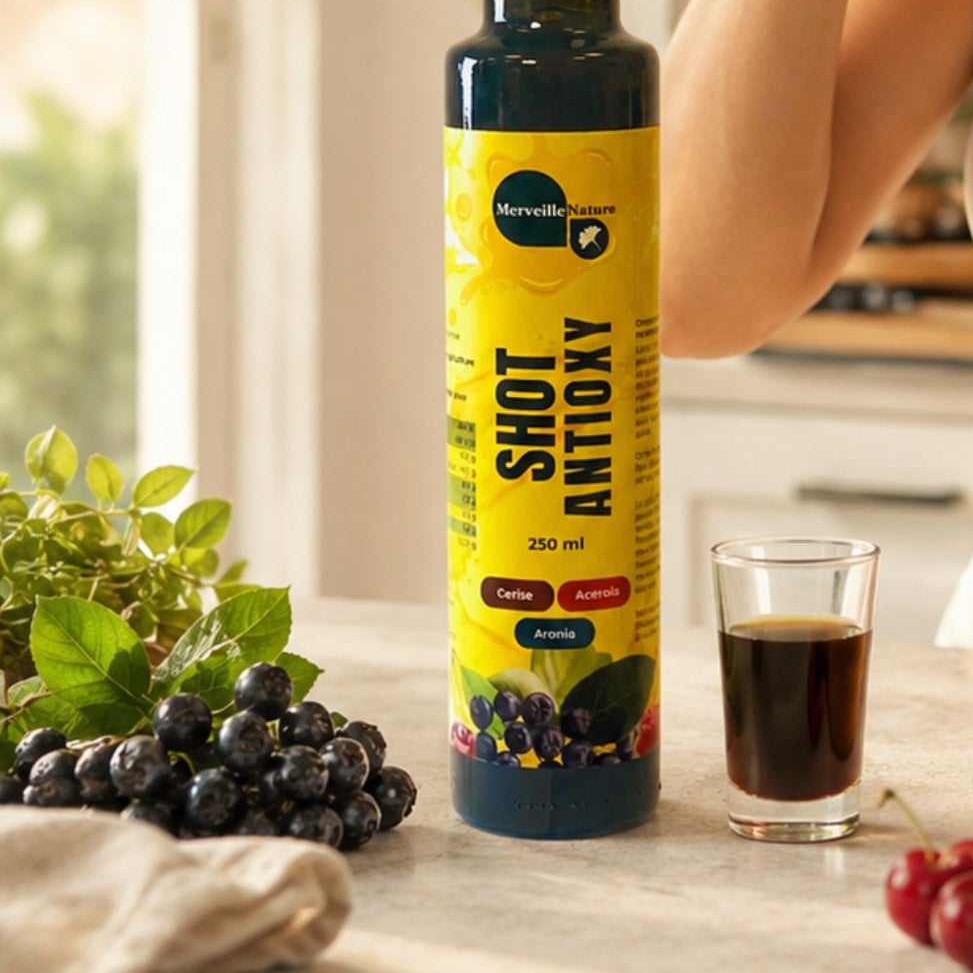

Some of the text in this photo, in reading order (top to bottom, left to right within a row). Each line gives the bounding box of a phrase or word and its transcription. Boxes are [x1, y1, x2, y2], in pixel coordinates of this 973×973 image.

[496, 202, 616, 217] Merveille Nature
[495, 347, 556, 482] SHOT
[563, 316, 612, 517] ANTIOXY
[528, 537, 585, 551] 250 ml
[496, 587, 534, 602] Cerise
[533, 628, 576, 640] Aronia
